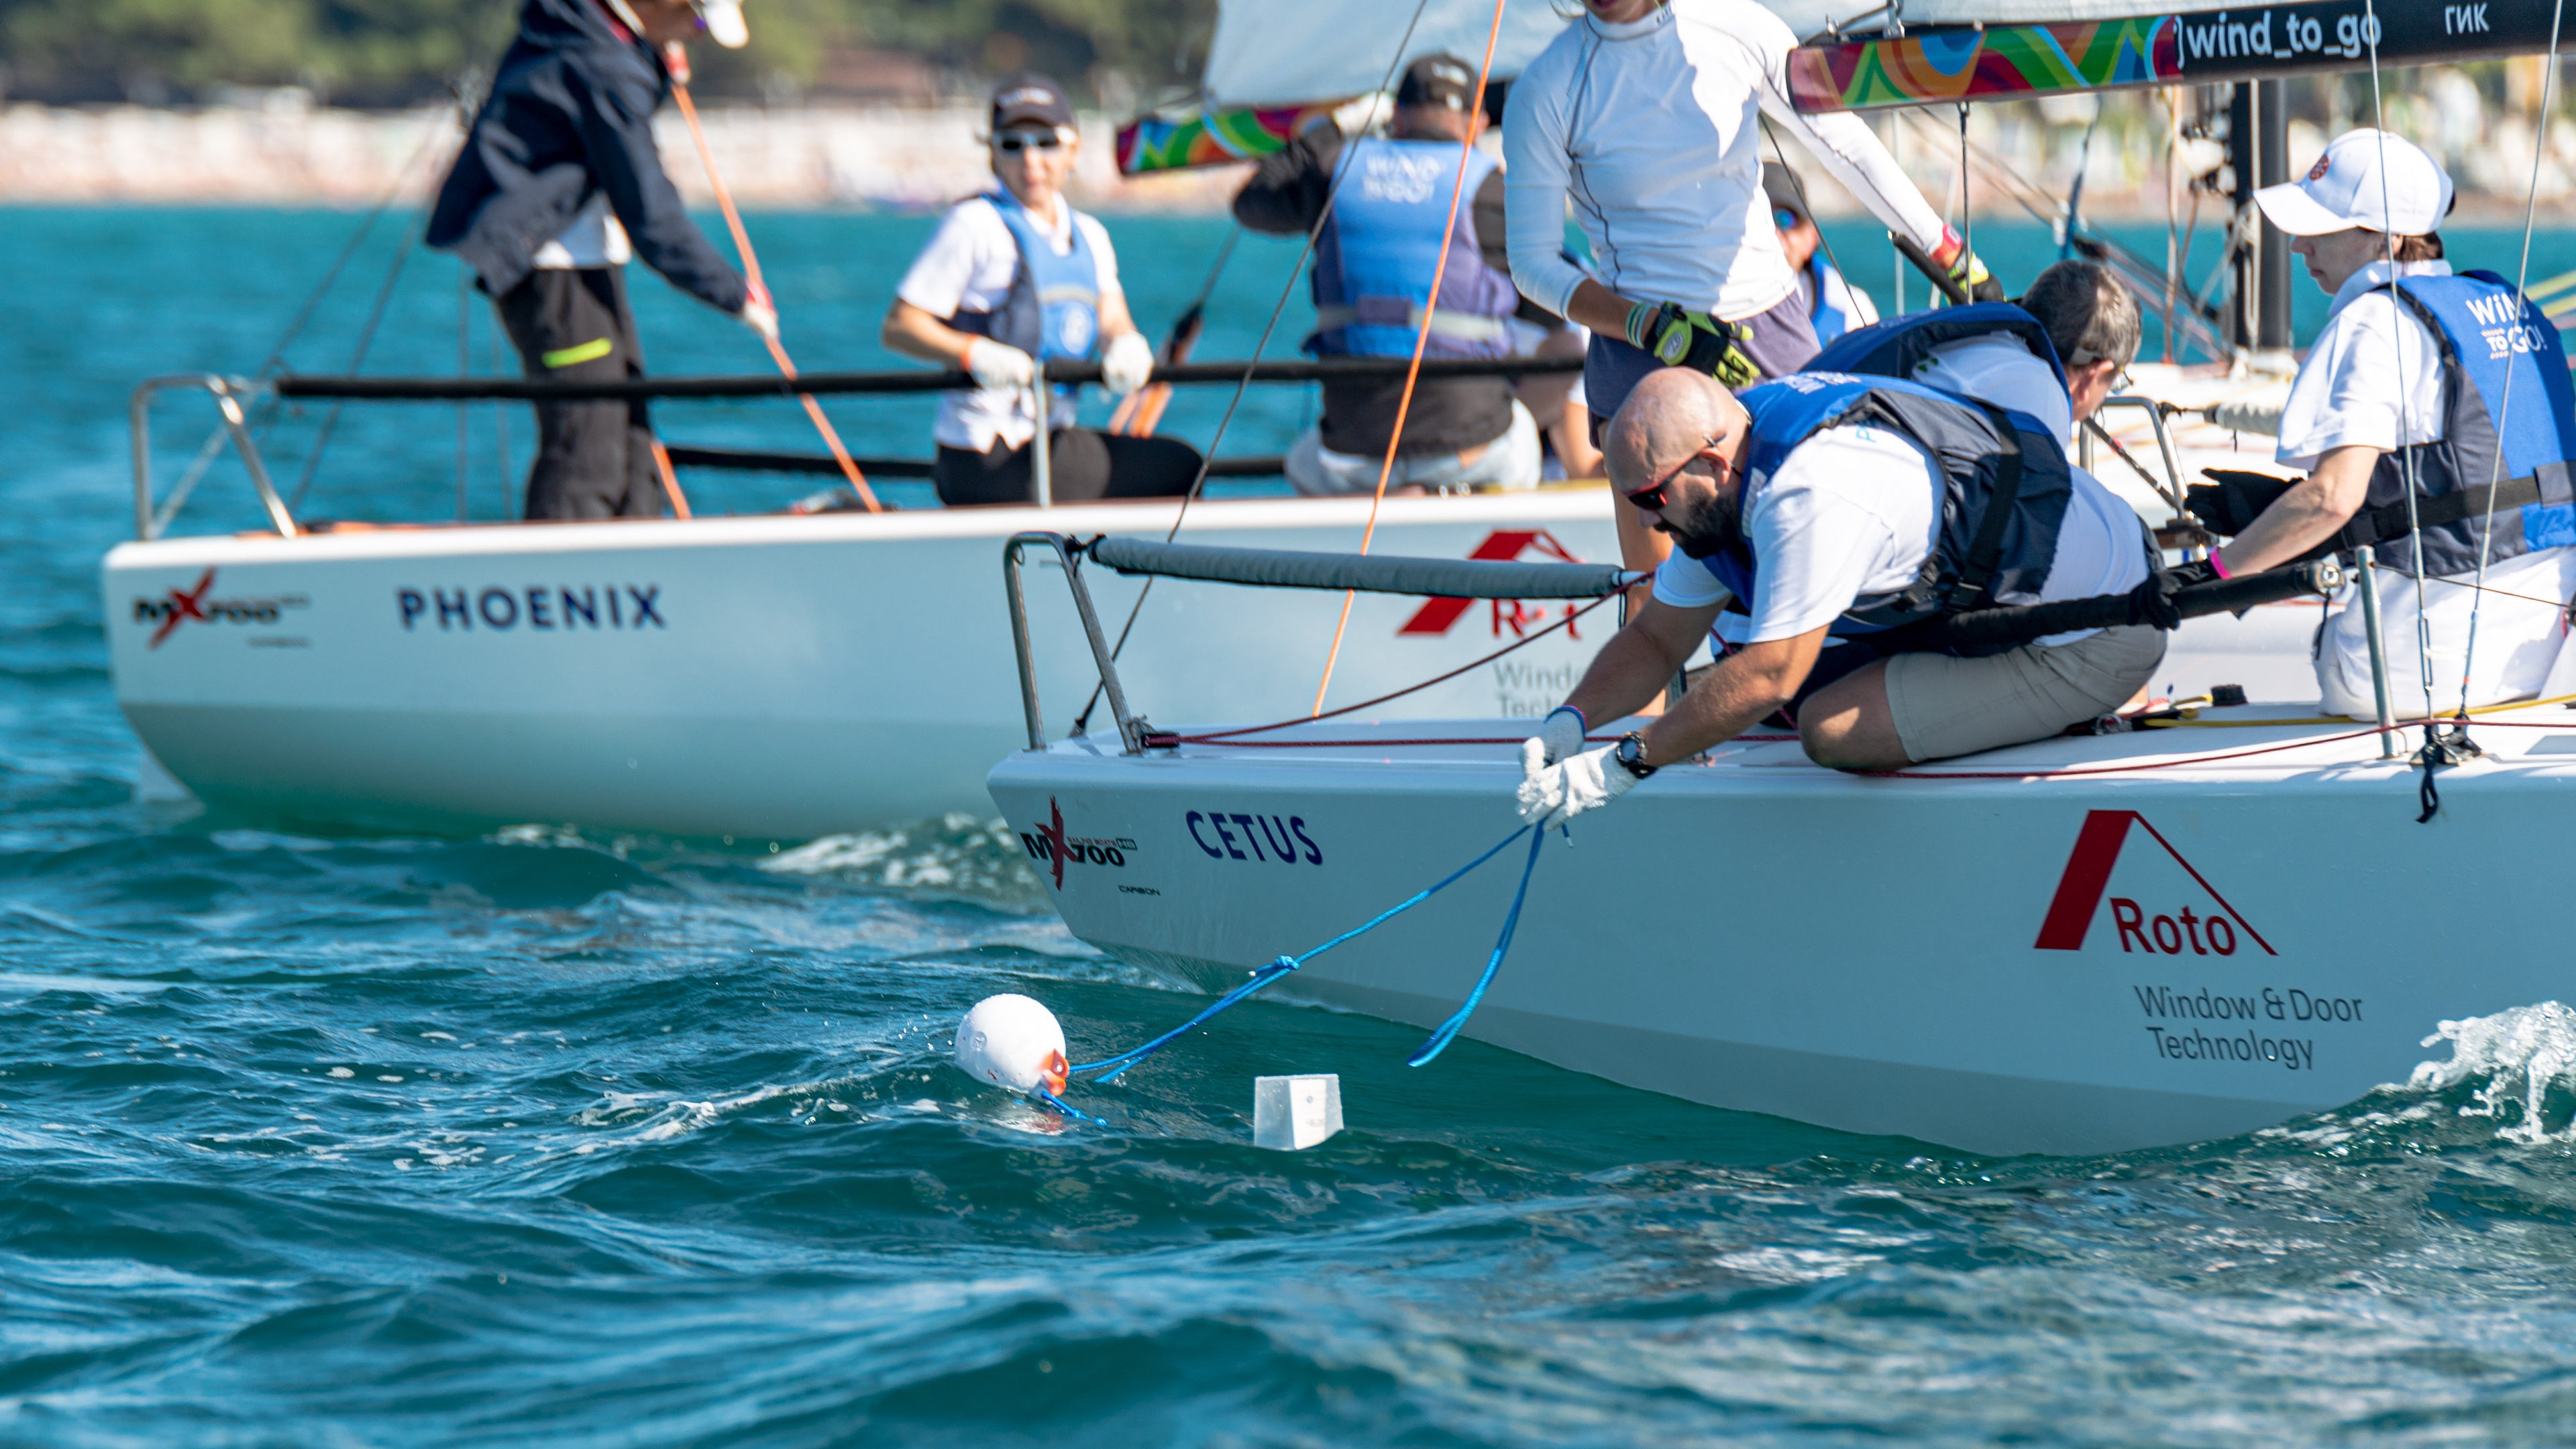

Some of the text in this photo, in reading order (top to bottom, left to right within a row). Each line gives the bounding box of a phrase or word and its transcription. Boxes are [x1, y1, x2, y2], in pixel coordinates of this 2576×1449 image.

[2186, 10, 2382, 59] wind_to_go
[2486, 335, 2508, 352] TO
[396, 584, 666, 631] PHOENIX
[1185, 810, 1324, 865] CETUS
[2109, 897, 2237, 956] Roto
[2134, 985, 2363, 1022] Window & Door
[2146, 1026, 2314, 1071] Technology
